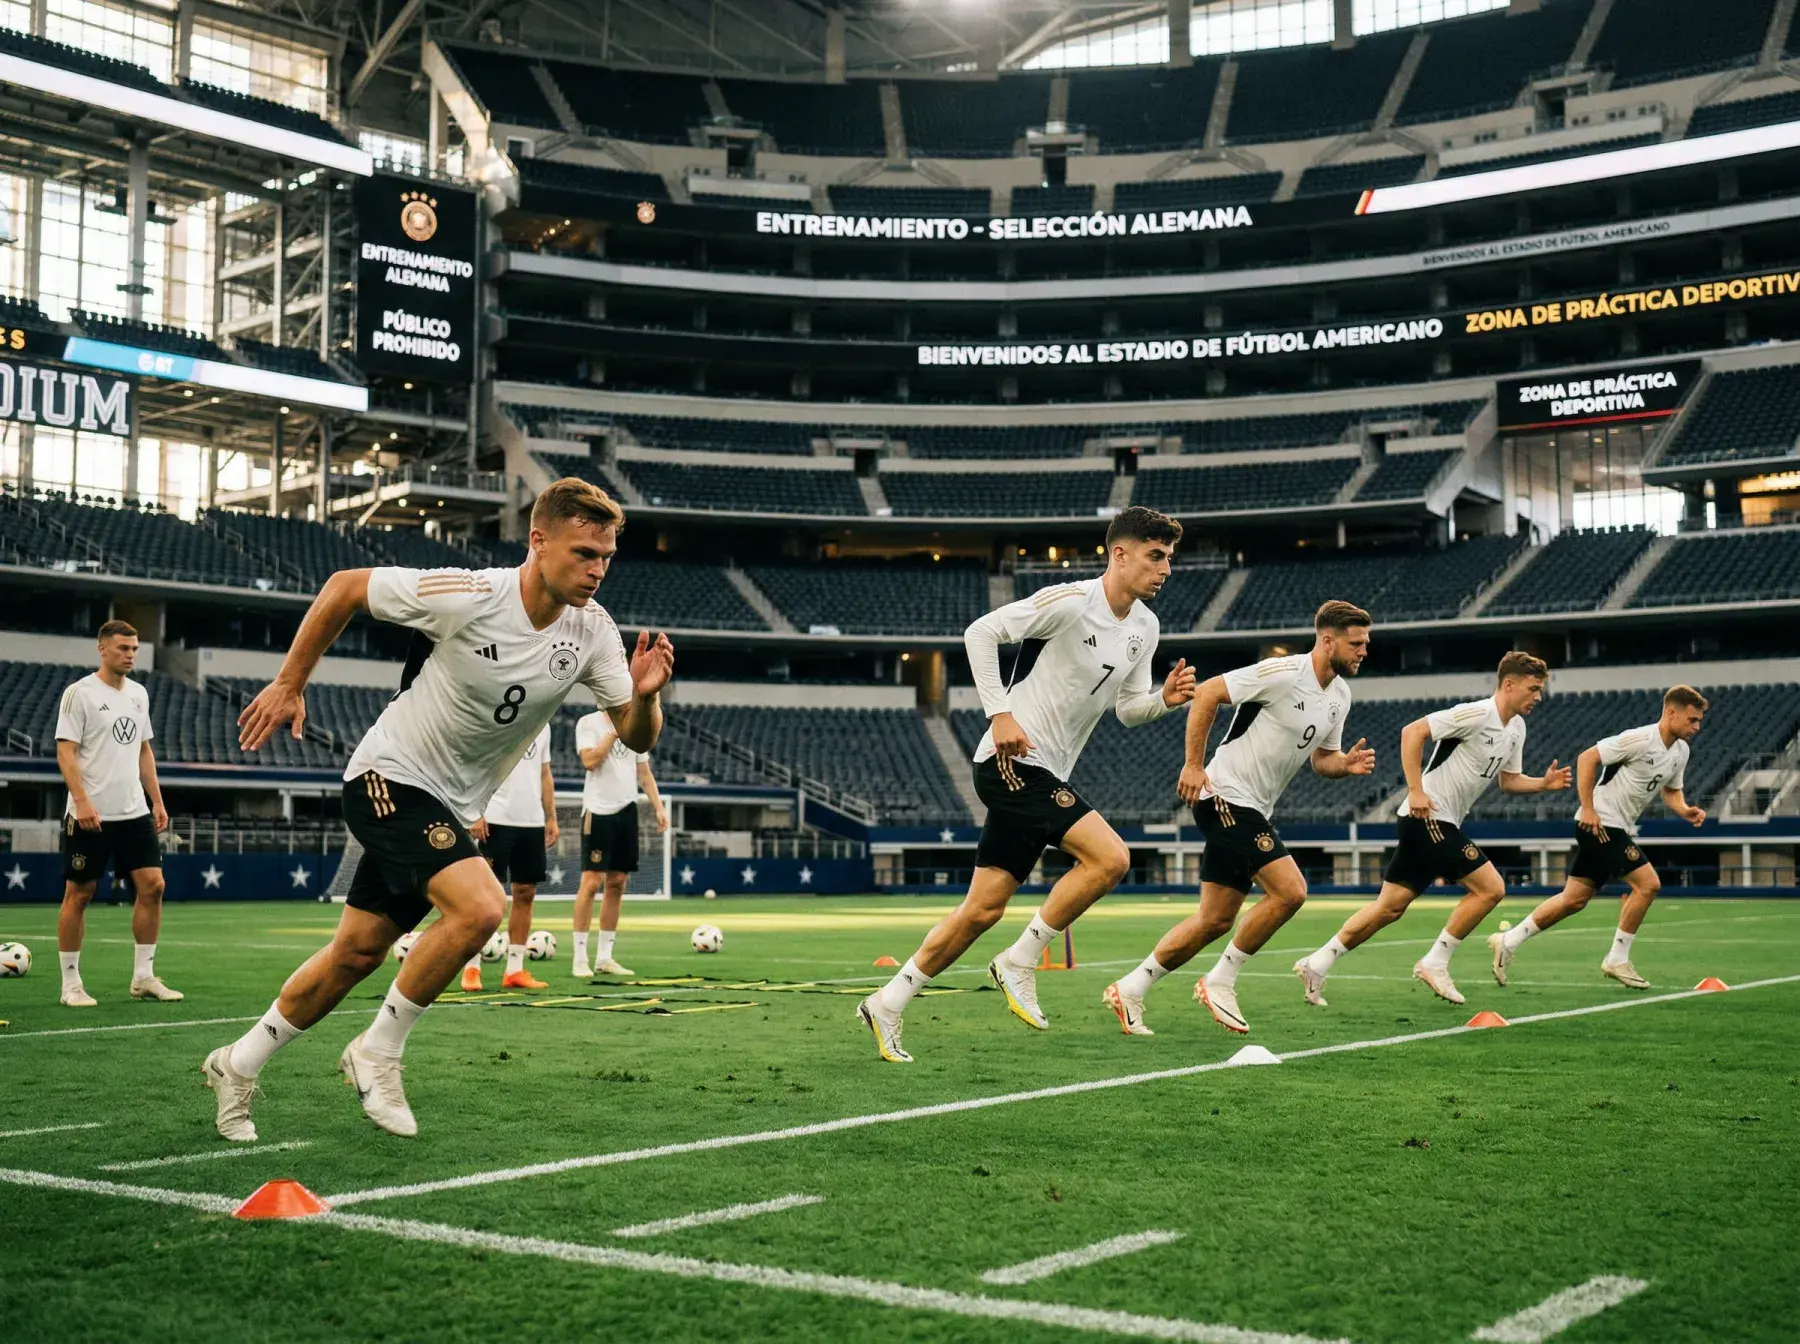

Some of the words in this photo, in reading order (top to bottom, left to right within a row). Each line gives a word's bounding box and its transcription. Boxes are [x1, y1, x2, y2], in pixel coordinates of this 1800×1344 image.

[757, 212, 969, 240] ENTRENAMIENTO
[988, 211, 1127, 240] SELECCIÓN
[1130, 205, 1253, 235] ALEMANA
[1545, 239, 1558, 248] DE
[1603, 221, 1671, 240] AMERICANO
[361, 242, 474, 278] ENTRENAMIENTO
[385, 266, 451, 293] ALEMANA
[383, 308, 451, 339] PÚBLICO
[1465, 308, 1528, 334] ZONA
[1532, 302, 1562, 326] DE
[1566, 288, 1679, 322] PRÁCTICA
[372, 330, 461, 362] PROHIBIDO
[918, 345, 1063, 365] BIENVENIDOS
[1065, 344, 1094, 363] AL
[1097, 340, 1189, 362] ESTADIO
[1192, 337, 1222, 358] DE
[1226, 331, 1310, 356] FÚTBOL
[1312, 318, 1443, 349] AMERICANO
[1519, 382, 1566, 403] ZONA
[1568, 380, 1591, 397] DE
[1594, 371, 1677, 395] PRÁCTICA
[1551, 392, 1645, 417] DEPORTIVA
[1090, 663, 1116, 696] 7
[493, 684, 527, 725] 8
[1297, 724, 1317, 750] 9
[1480, 756, 1503, 779] 11
